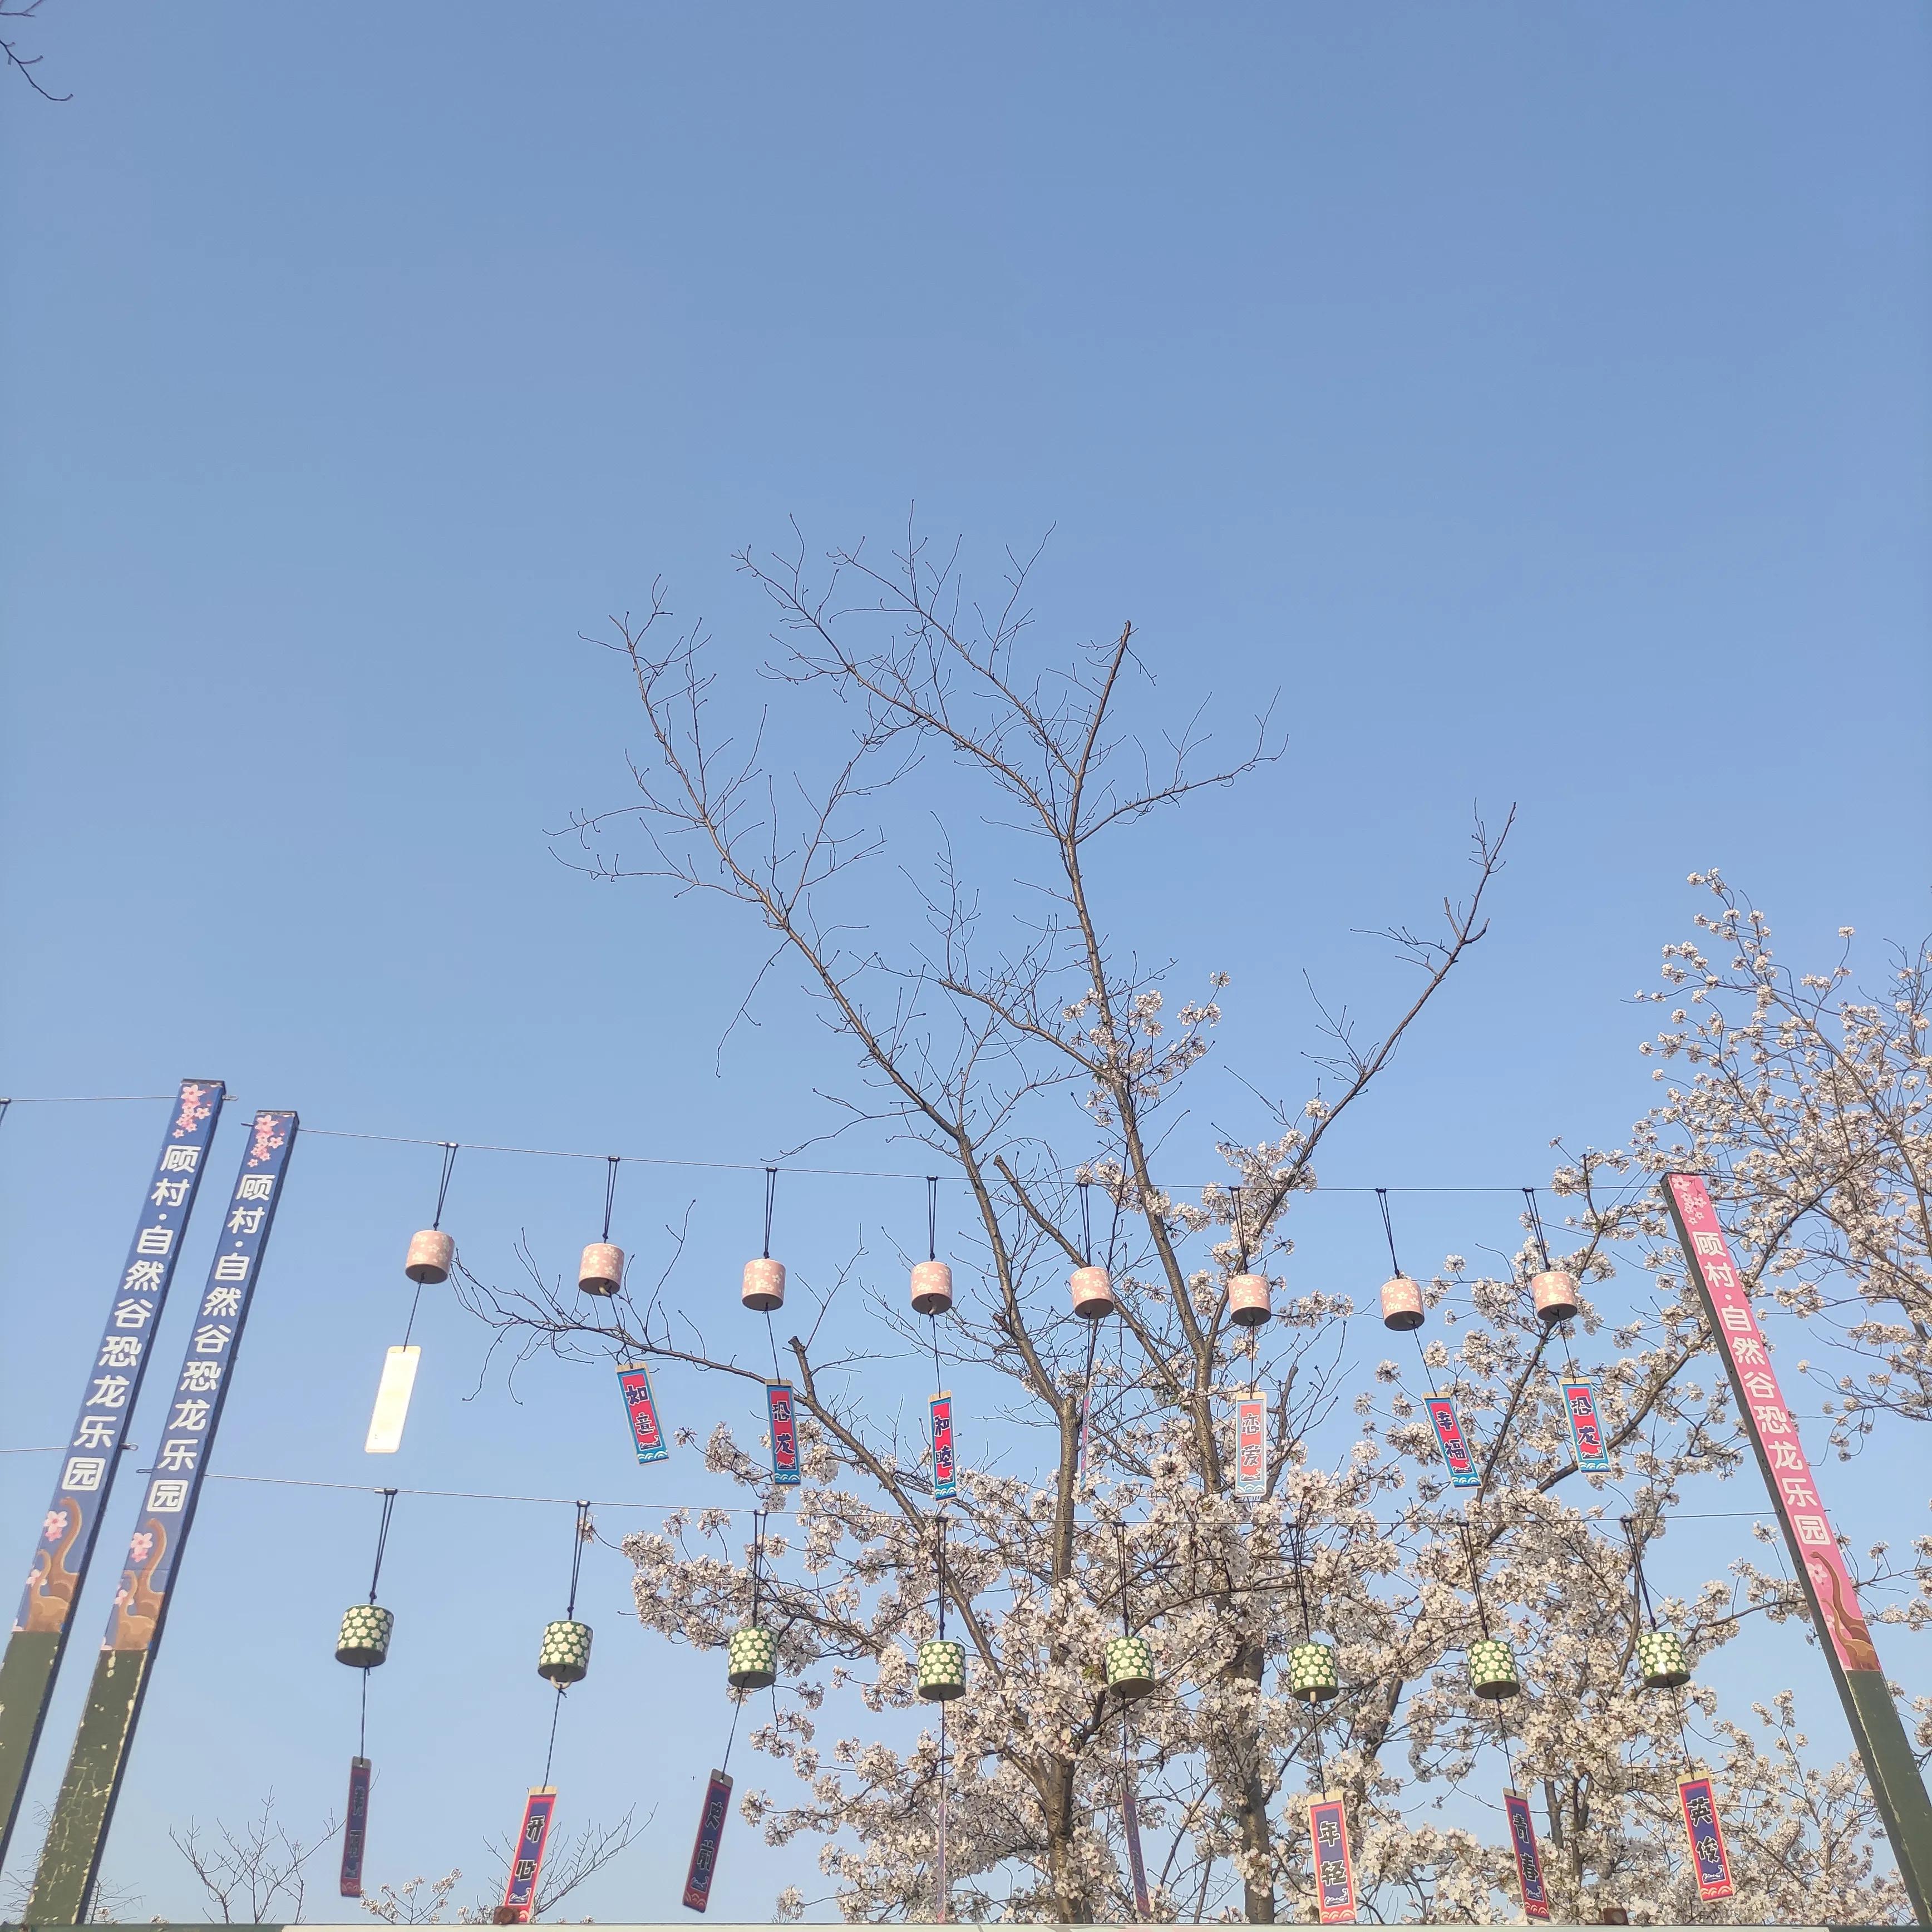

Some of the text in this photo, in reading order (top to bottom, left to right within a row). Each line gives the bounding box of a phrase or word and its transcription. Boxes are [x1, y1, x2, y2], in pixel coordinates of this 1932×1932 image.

[625, 1384, 656, 1435] 如意
[771, 1401, 795, 1454] 恐龙
[1436, 1411, 1466, 1460] 幸福
[1570, 1397, 1599, 1445] 恐龙
[934, 1415, 953, 1468] 和睦
[1240, 1413, 1261, 1466] 恋爱
[1318, 1821, 1347, 1886] 年轻
[1512, 1813, 1539, 1882] 青春
[1687, 1796, 1719, 1863] 英俊
